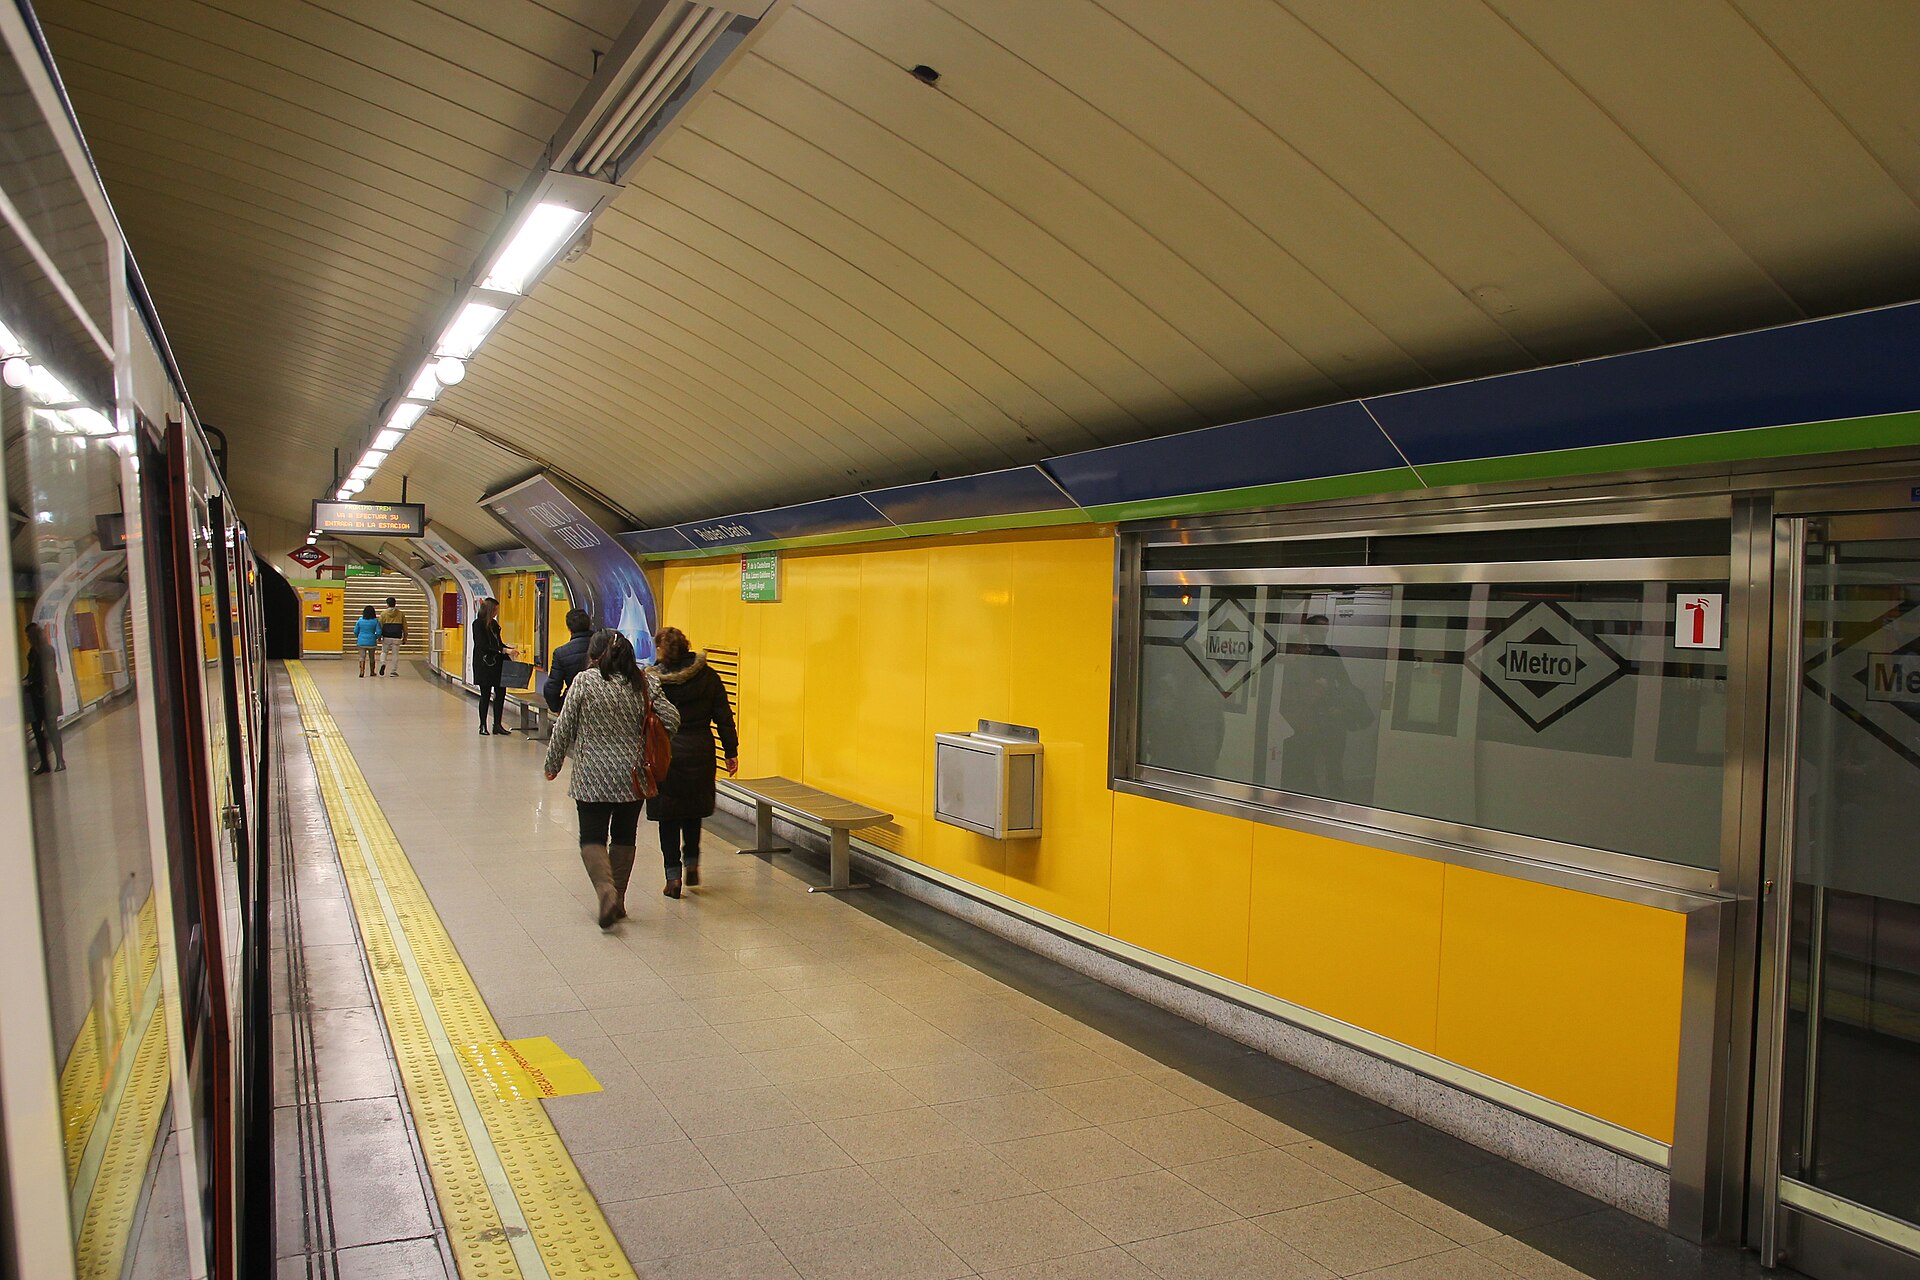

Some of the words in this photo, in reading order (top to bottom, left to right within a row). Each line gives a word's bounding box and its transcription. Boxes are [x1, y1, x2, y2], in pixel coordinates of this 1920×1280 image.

[324, 520, 353, 528] ENTRADA
[367, 521, 376, 529] LA
[554, 523, 601, 550] HIELO
[1209, 636, 1246, 655] Metro
[1510, 649, 1571, 676] Metro
